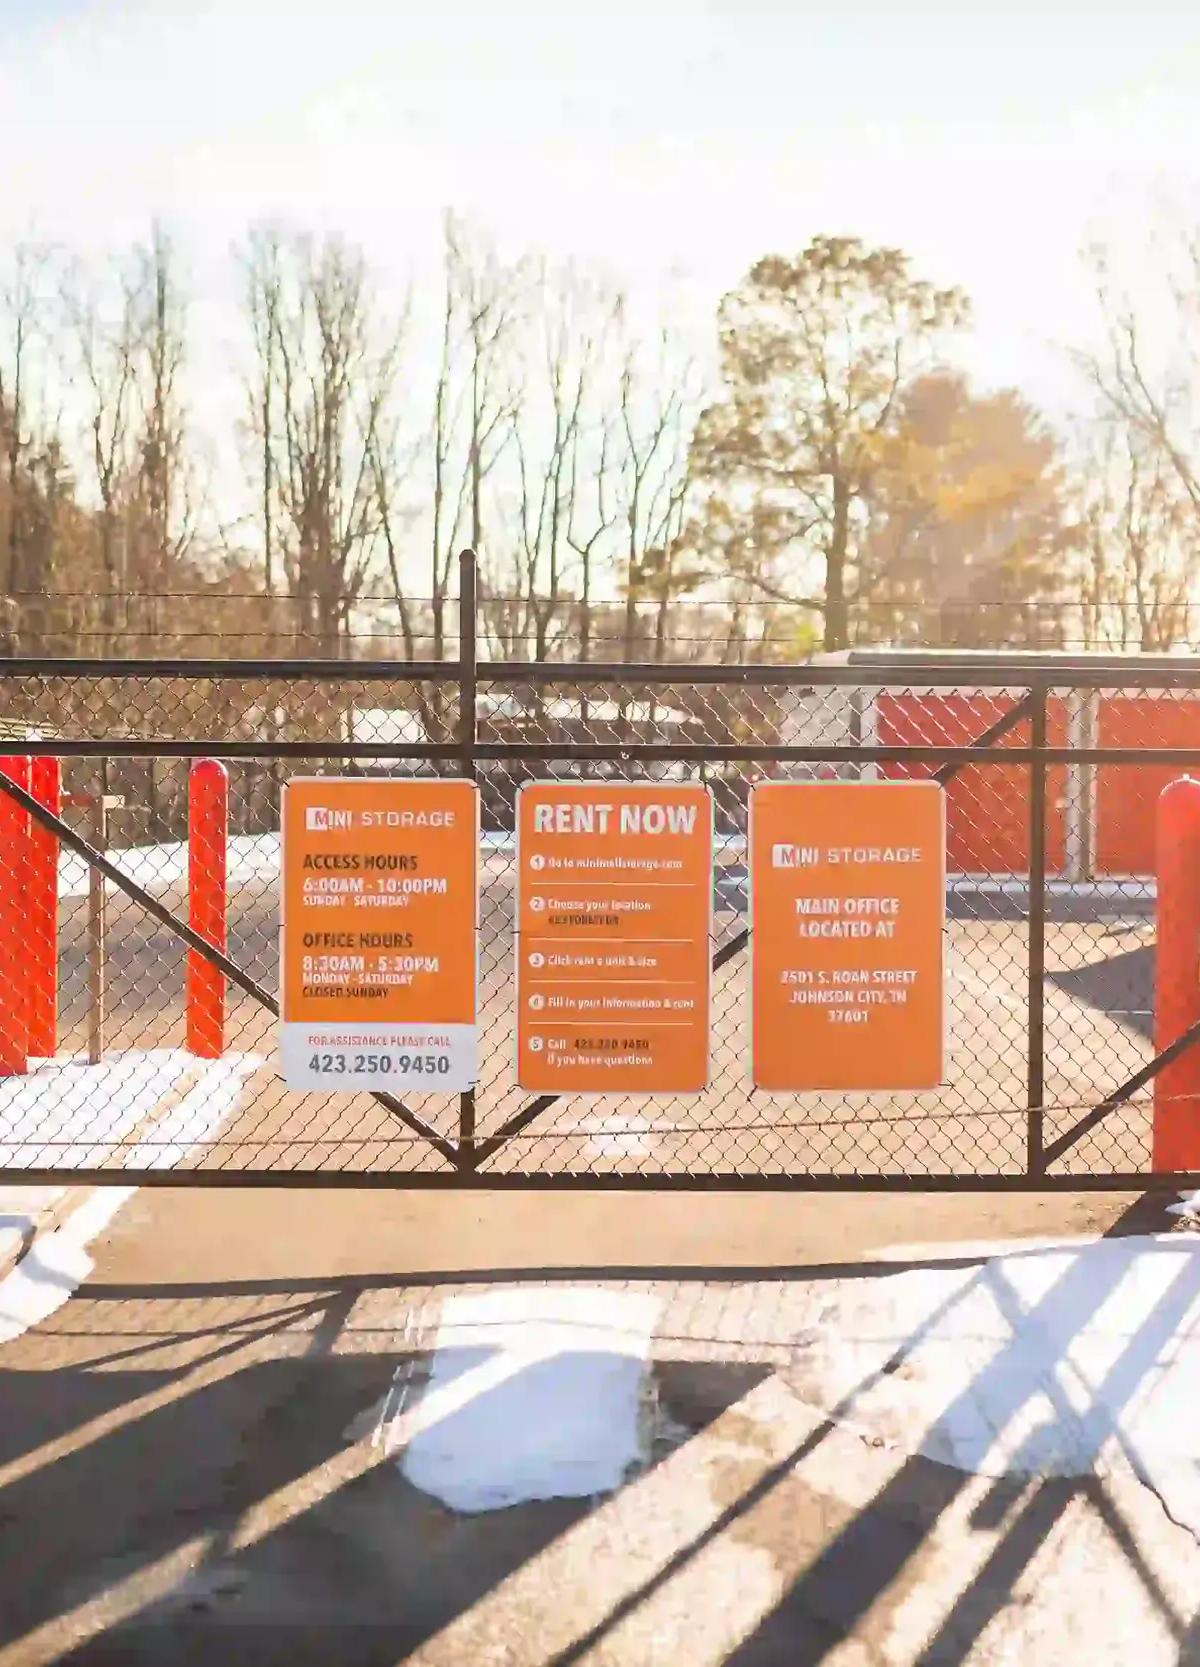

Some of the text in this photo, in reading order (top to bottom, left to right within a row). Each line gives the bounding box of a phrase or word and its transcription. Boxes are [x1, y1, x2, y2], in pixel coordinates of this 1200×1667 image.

[361, 811, 455, 827] STORAGE
[534, 804, 697, 835] RENT NOW
[303, 855, 418, 870] ACCESS HOURS
[827, 848, 923, 864] STORAGE
[303, 877, 364, 894] 6:00AM
[377, 878, 447, 895] 10:00PM
[303, 895, 409, 907] SUNDAY SATURDAY
[795, 898, 900, 914] MAIN OFFICE
[800, 921, 896, 937] LOCATED AT
[303, 933, 414, 948] OFFICE HOURS
[302, 955, 364, 972] 8:30AM
[378, 956, 439, 973] 5:30PM
[302, 973, 350, 985] MONDAY
[358, 973, 414, 985] SATURDAY
[872, 970, 917, 985] STREET
[302, 986, 389, 998] CLOSED SUNDAY
[789, 990, 854, 1004] JOHNSON
[548, 997, 563, 1008] Fill
[566, 997, 576, 1008] in
[548, 1039, 566, 1050] Call
[308, 1054, 450, 1074] 423.250.9450
